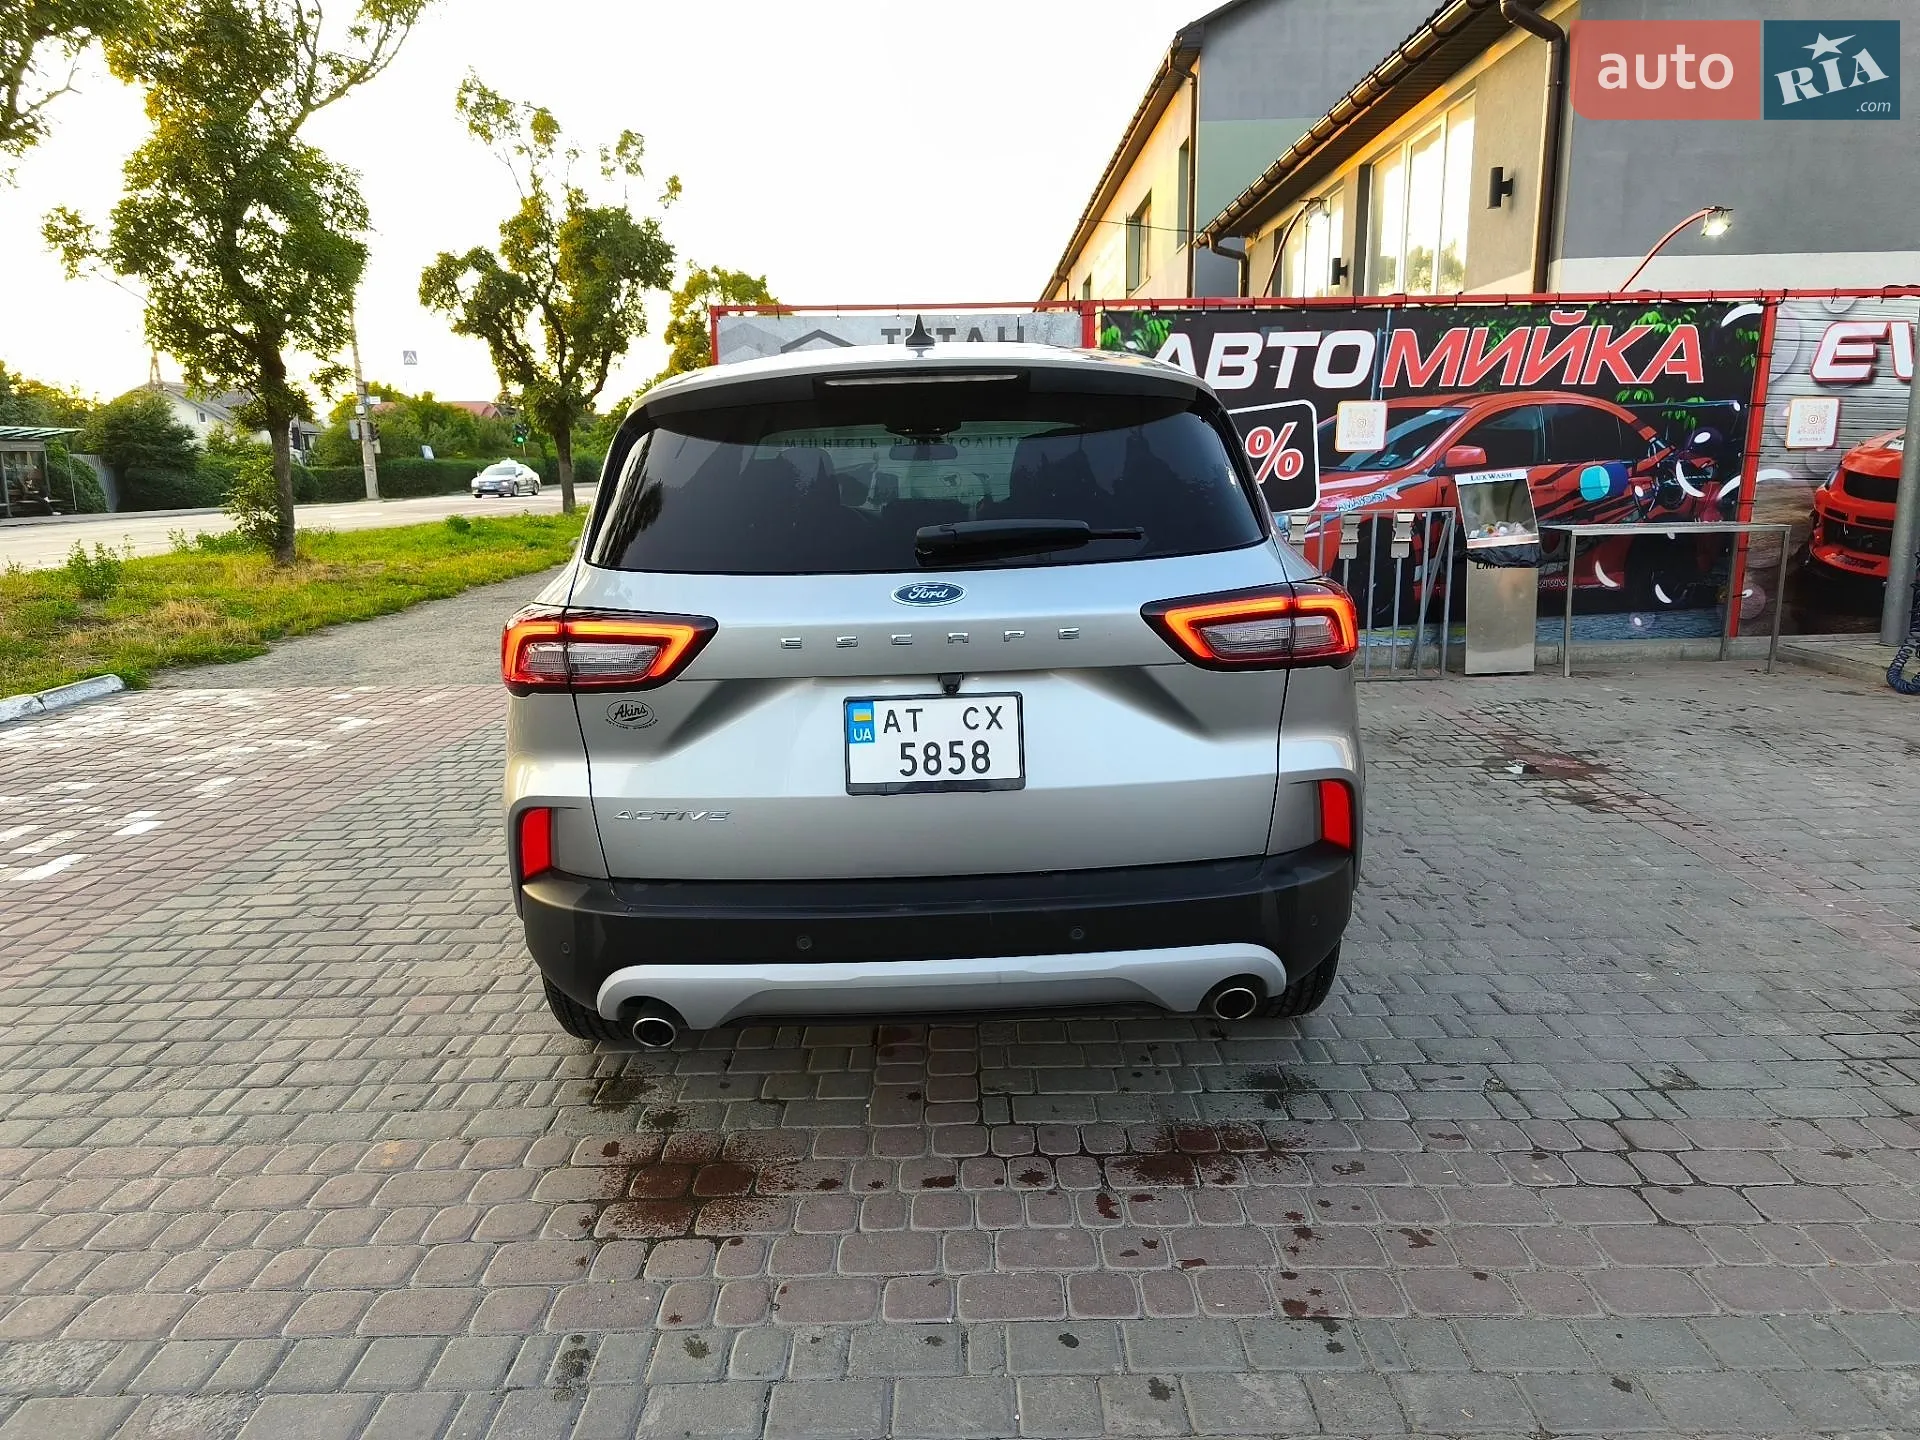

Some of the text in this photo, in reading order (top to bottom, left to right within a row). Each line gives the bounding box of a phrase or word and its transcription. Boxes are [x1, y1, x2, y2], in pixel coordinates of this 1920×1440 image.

[1154, 309, 1704, 390] АВТОМИЙКА
[908, 585, 949, 602] Ford
[780, 626, 1081, 650] ESCAPE
[883, 705, 1004, 734] AT CX
[853, 727, 873, 742] UA
[899, 740, 991, 777] 5858
[614, 809, 732, 822] ACTIVE
